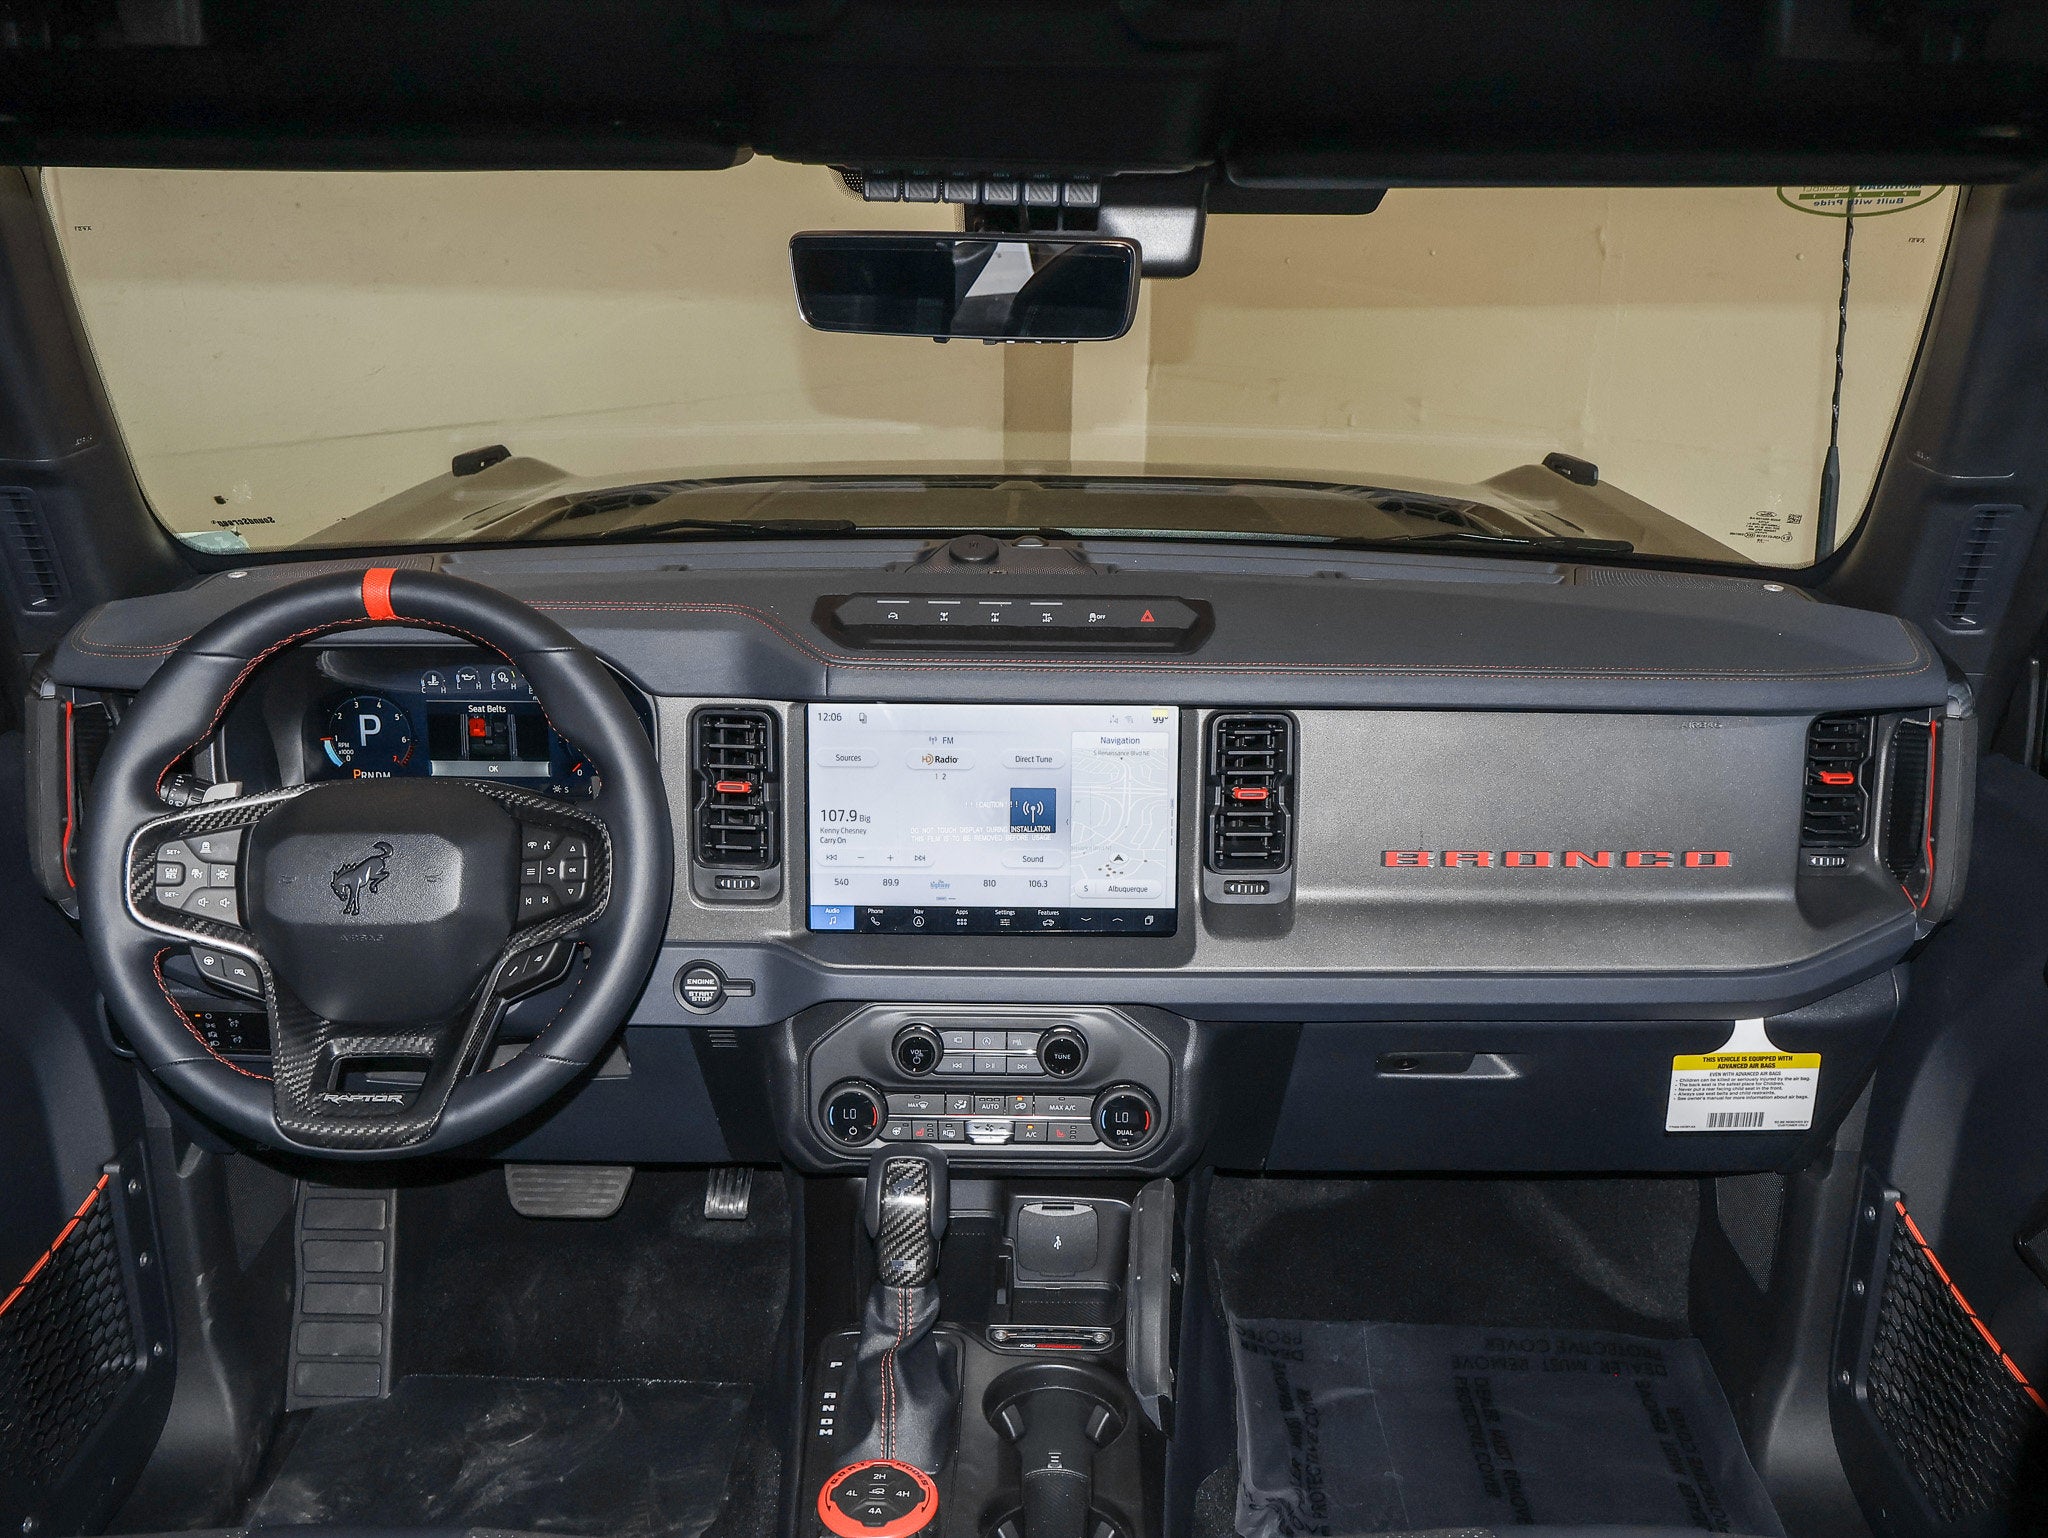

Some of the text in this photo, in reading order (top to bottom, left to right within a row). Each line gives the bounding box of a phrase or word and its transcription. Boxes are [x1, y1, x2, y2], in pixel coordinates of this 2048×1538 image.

[468, 705, 507, 713] Seat Belts
[817, 712, 843, 722] 12:06
[359, 714, 382, 747] P
[942, 736, 954, 745] FM
[1100, 737, 1141, 746] Navigation
[835, 753, 862, 763] Sources
[934, 755, 959, 764] Radio
[1015, 755, 1053, 764] Direct Tune
[488, 765, 499, 773] OK
[820, 809, 871, 824] 107.9 Big
[820, 827, 867, 836] Kenny Chesney
[959, 825, 983, 833] DISPLAY
[1010, 825, 1051, 833] INSTALLATION
[819, 837, 847, 846] Carry On
[1022, 855, 1044, 864] Sound
[1381, 850, 1732, 868] BRONCO
[834, 878, 900, 887] 540 89.9
[983, 879, 1048, 888] 810 106.3
[1108, 885, 1149, 894] Albuquerque
[955, 909, 969, 917] Apps
[994, 909, 1016, 917] Settings
[323, 1094, 405, 1106] RAPTOR
[843, 1108, 857, 1120] LO
[1115, 1112, 1129, 1123] LO
[829, 1361, 843, 1369] P
[819, 1428, 833, 1436] M
[896, 1462, 929, 1486] MODES
[895, 1490, 910, 1498] 4H
[868, 1507, 882, 1515] 4A
